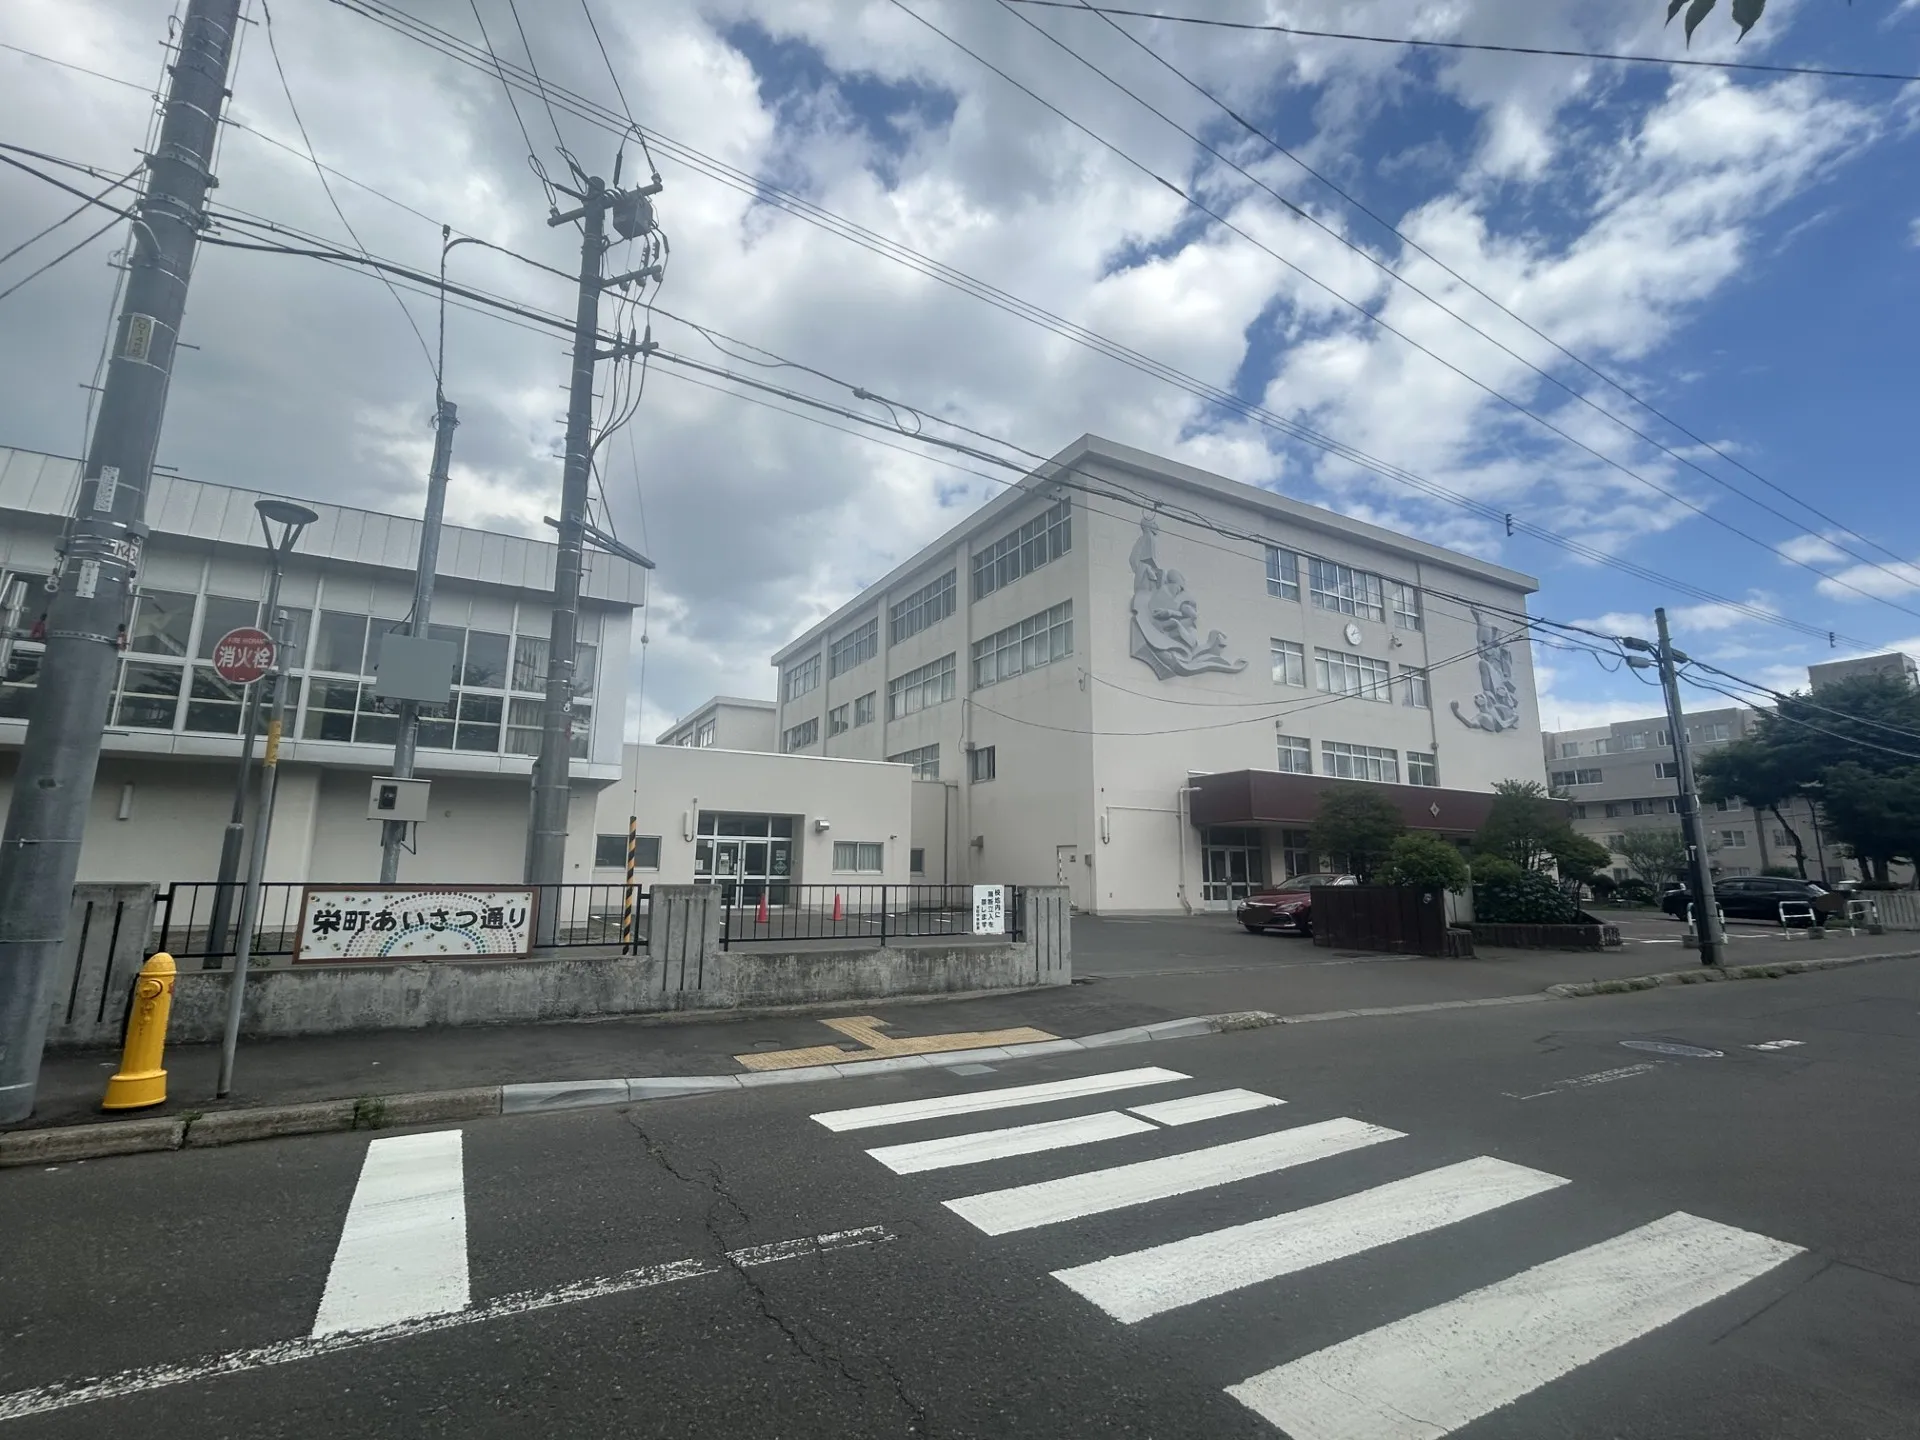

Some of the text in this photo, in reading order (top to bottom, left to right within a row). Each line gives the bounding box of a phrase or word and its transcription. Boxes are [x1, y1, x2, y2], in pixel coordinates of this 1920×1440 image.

[217, 645, 270, 668] 消火栓
[312, 907, 526, 934] 栄町あいさつ通り
